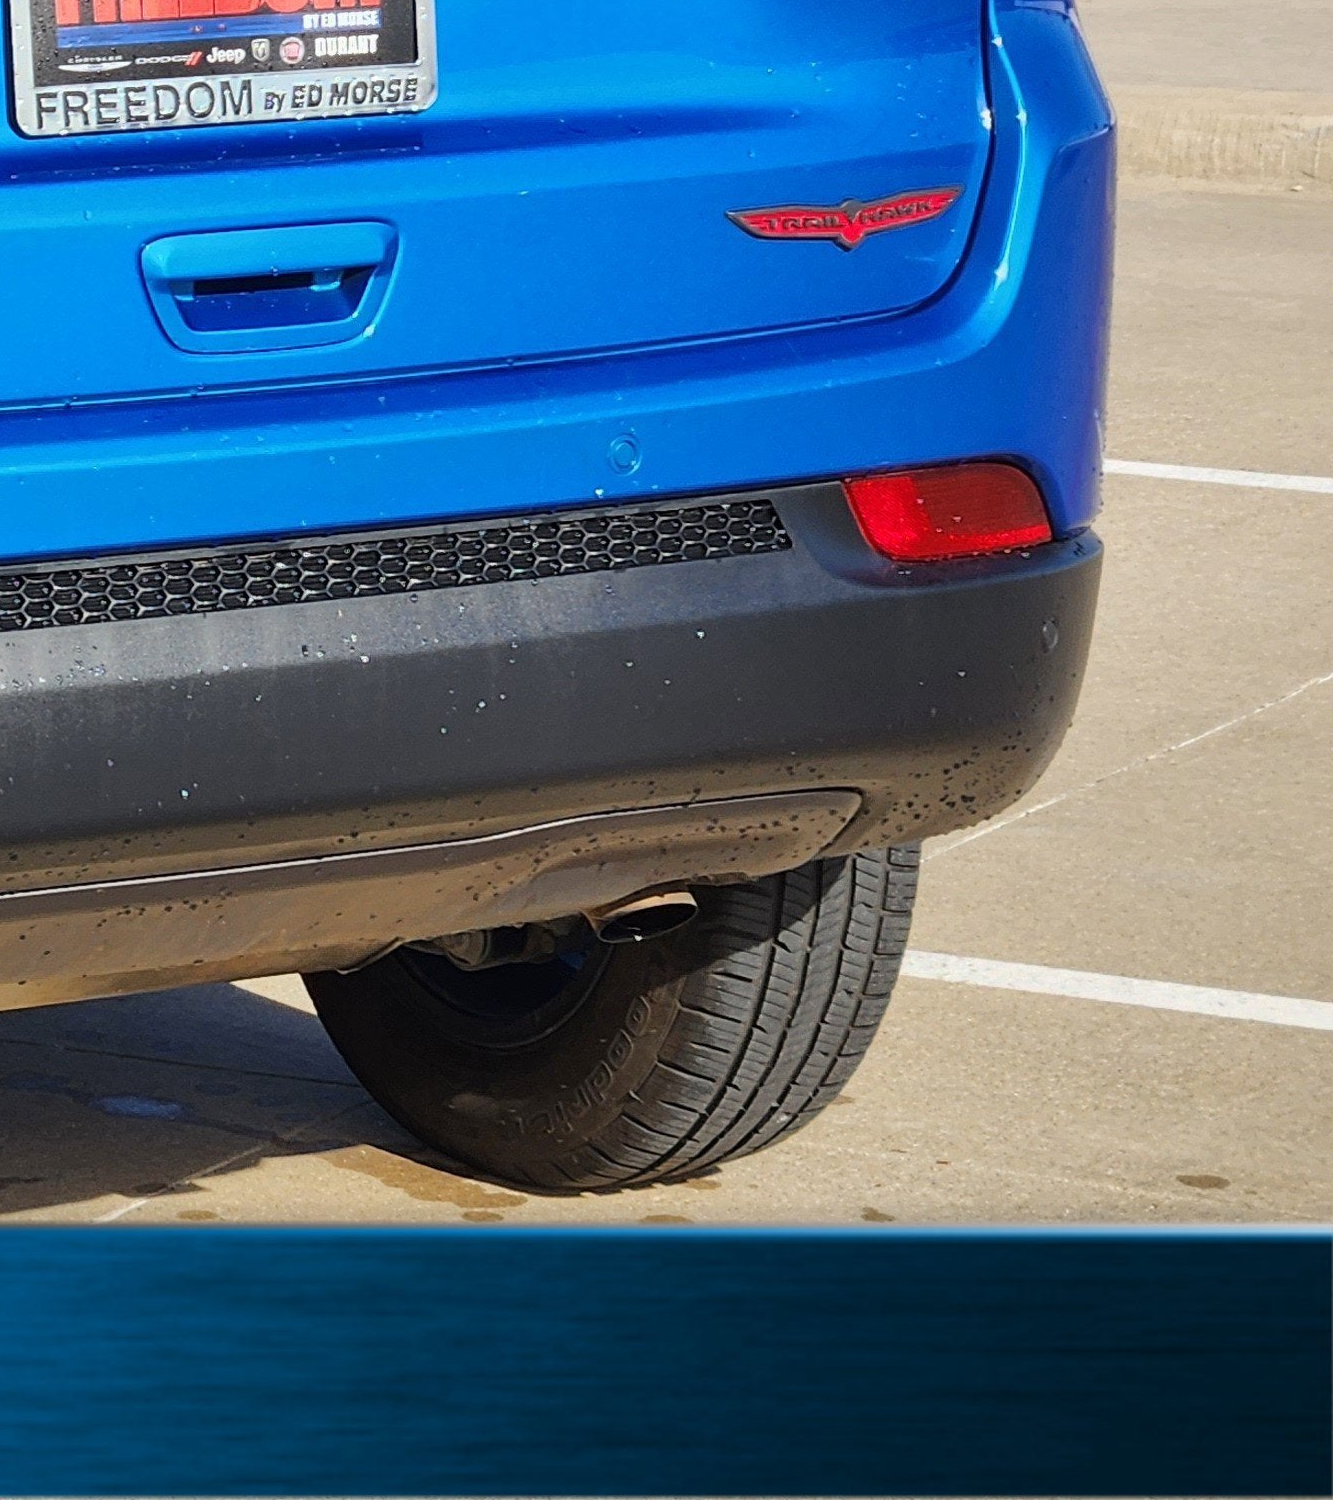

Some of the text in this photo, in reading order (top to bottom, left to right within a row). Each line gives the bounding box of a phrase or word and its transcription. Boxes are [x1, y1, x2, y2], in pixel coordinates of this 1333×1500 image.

[206, 46, 246, 65] Jeep
[314, 34, 379, 57] DURANT
[36, 79, 253, 130] FREEDOM
[291, 84, 323, 108] ED
[329, 77, 419, 107] MORSE
